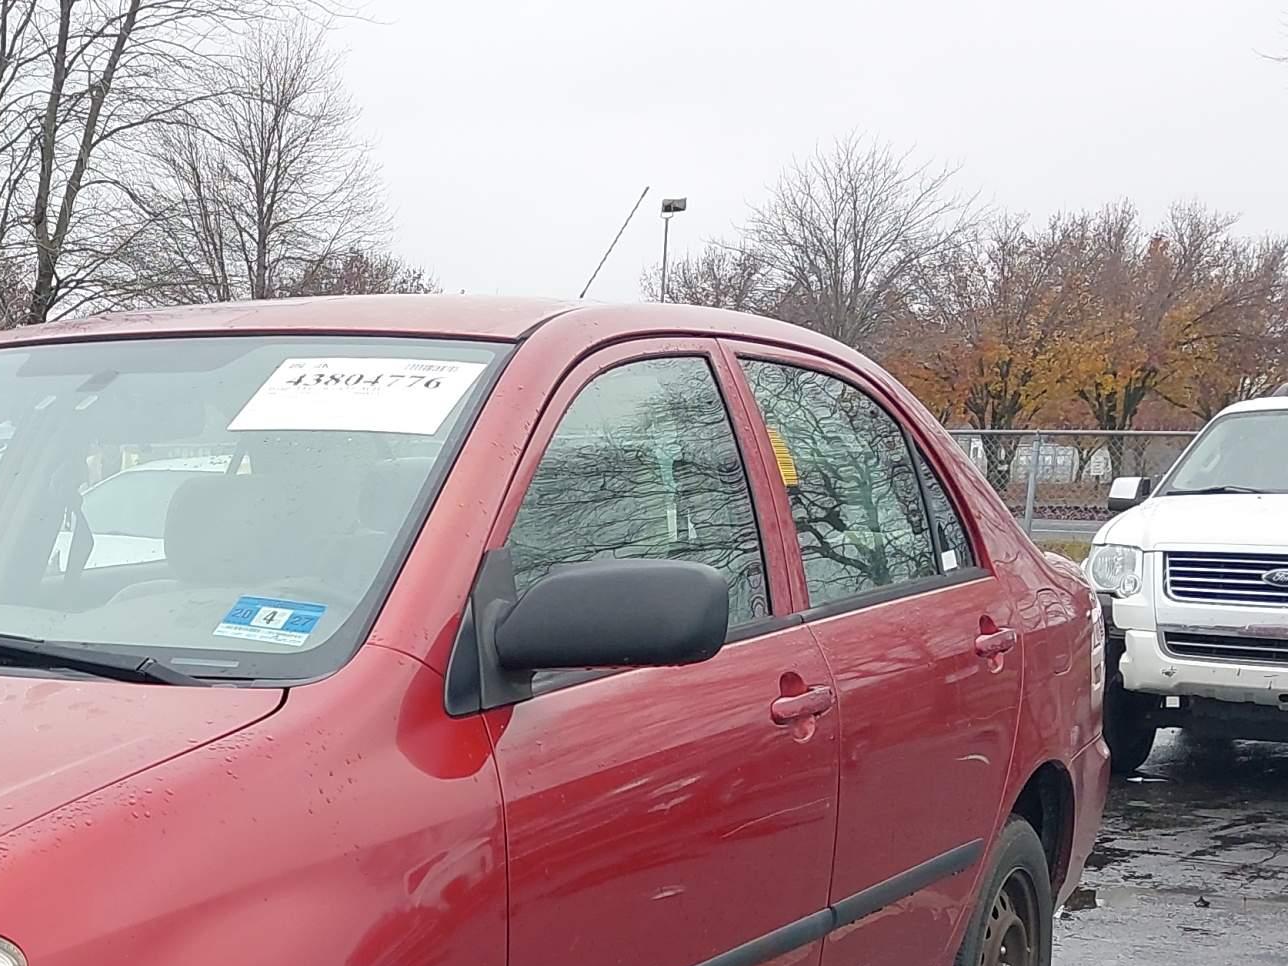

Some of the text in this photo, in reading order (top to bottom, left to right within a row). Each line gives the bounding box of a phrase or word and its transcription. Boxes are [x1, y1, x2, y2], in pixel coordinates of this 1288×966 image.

[285, 372, 447, 390] 43804776
[231, 608, 315, 627] 20 4 27
